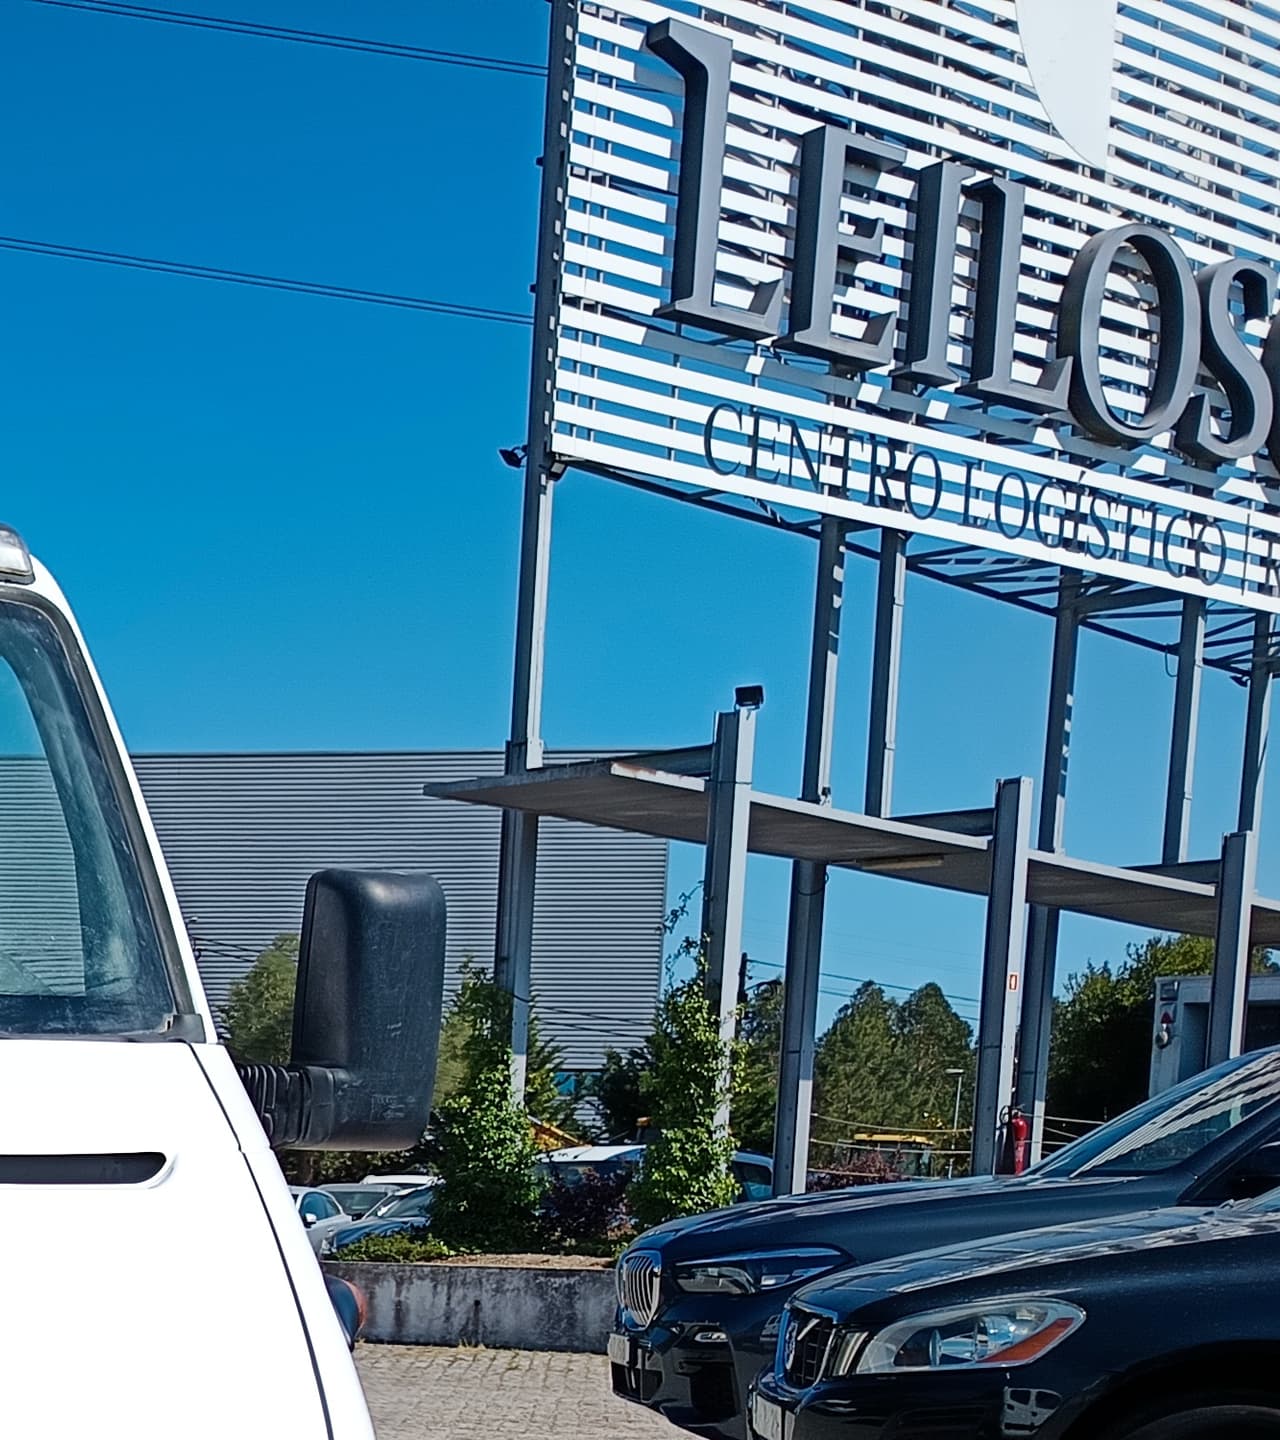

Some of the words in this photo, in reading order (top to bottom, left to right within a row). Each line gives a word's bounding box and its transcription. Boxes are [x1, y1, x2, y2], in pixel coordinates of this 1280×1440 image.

[645, 17, 1280, 467] LEILOS
[704, 403, 942, 520] CENTRO
[957, 459, 1227, 586] LOGÍSTICO
